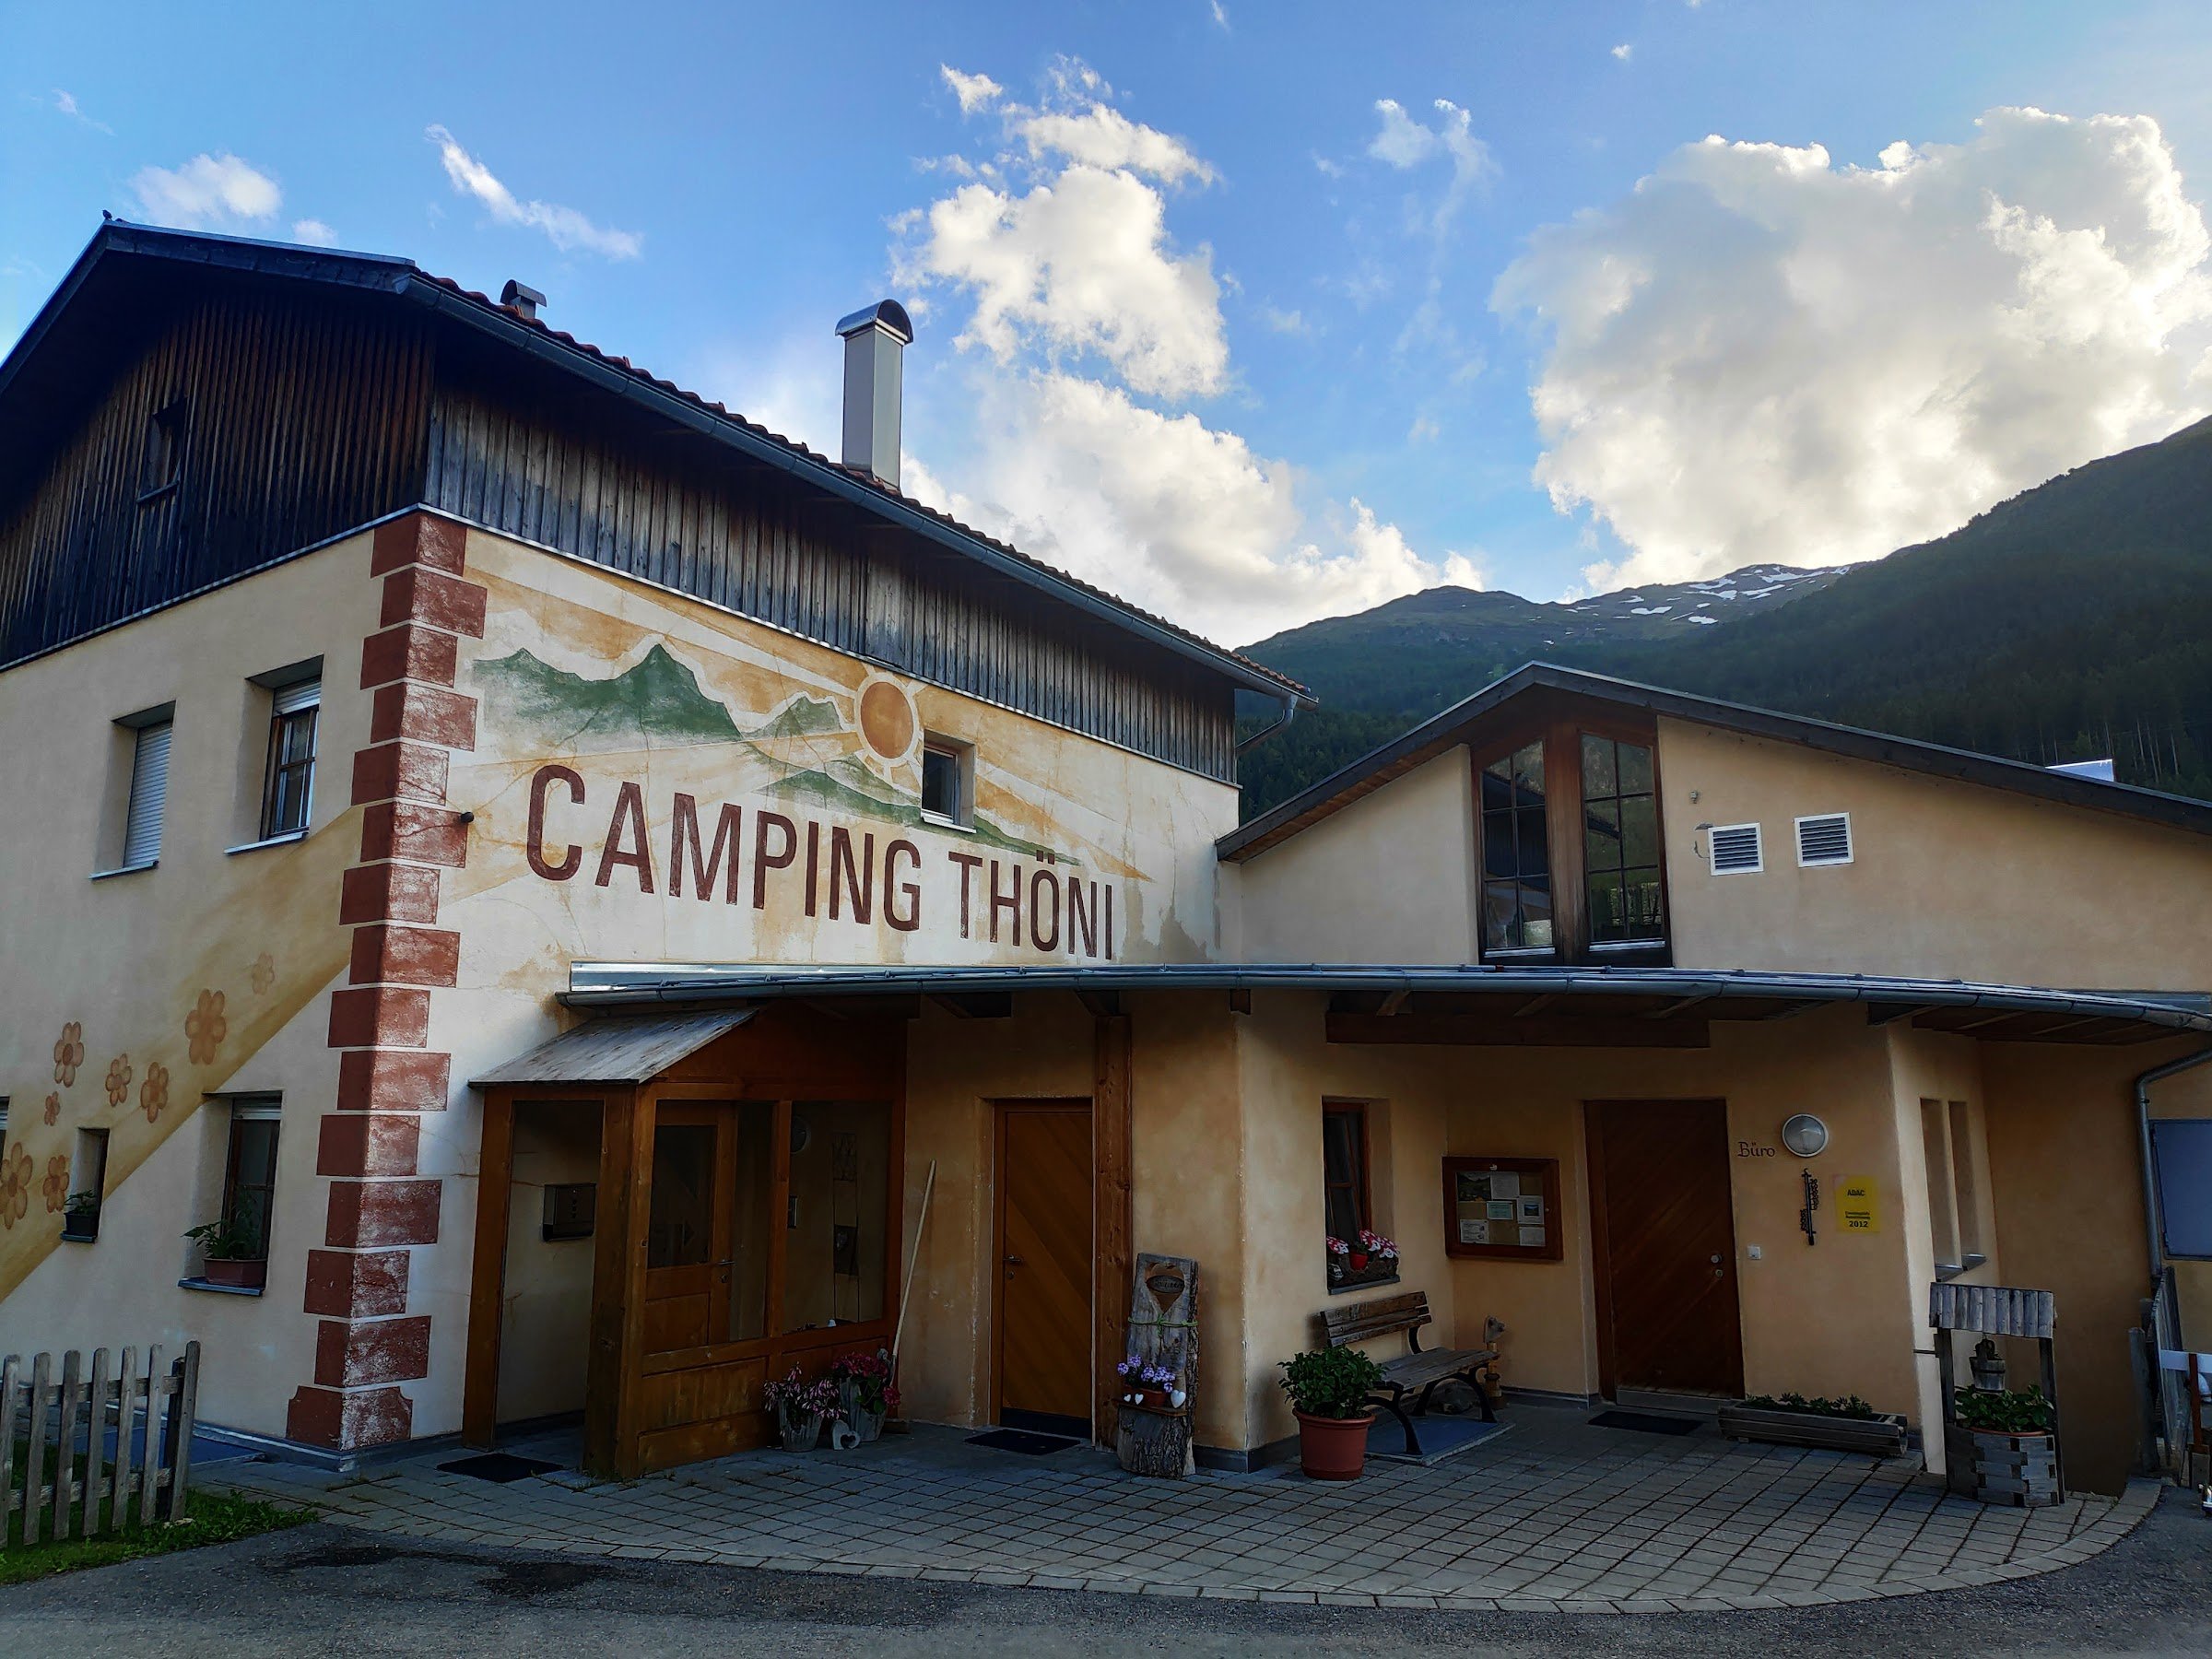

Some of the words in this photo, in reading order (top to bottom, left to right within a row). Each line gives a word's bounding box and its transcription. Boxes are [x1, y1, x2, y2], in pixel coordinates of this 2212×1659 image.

[526, 764, 922, 932] CAMPING
[947, 849, 1113, 960] THÖNI
[1737, 1141, 1775, 1158] Büro
